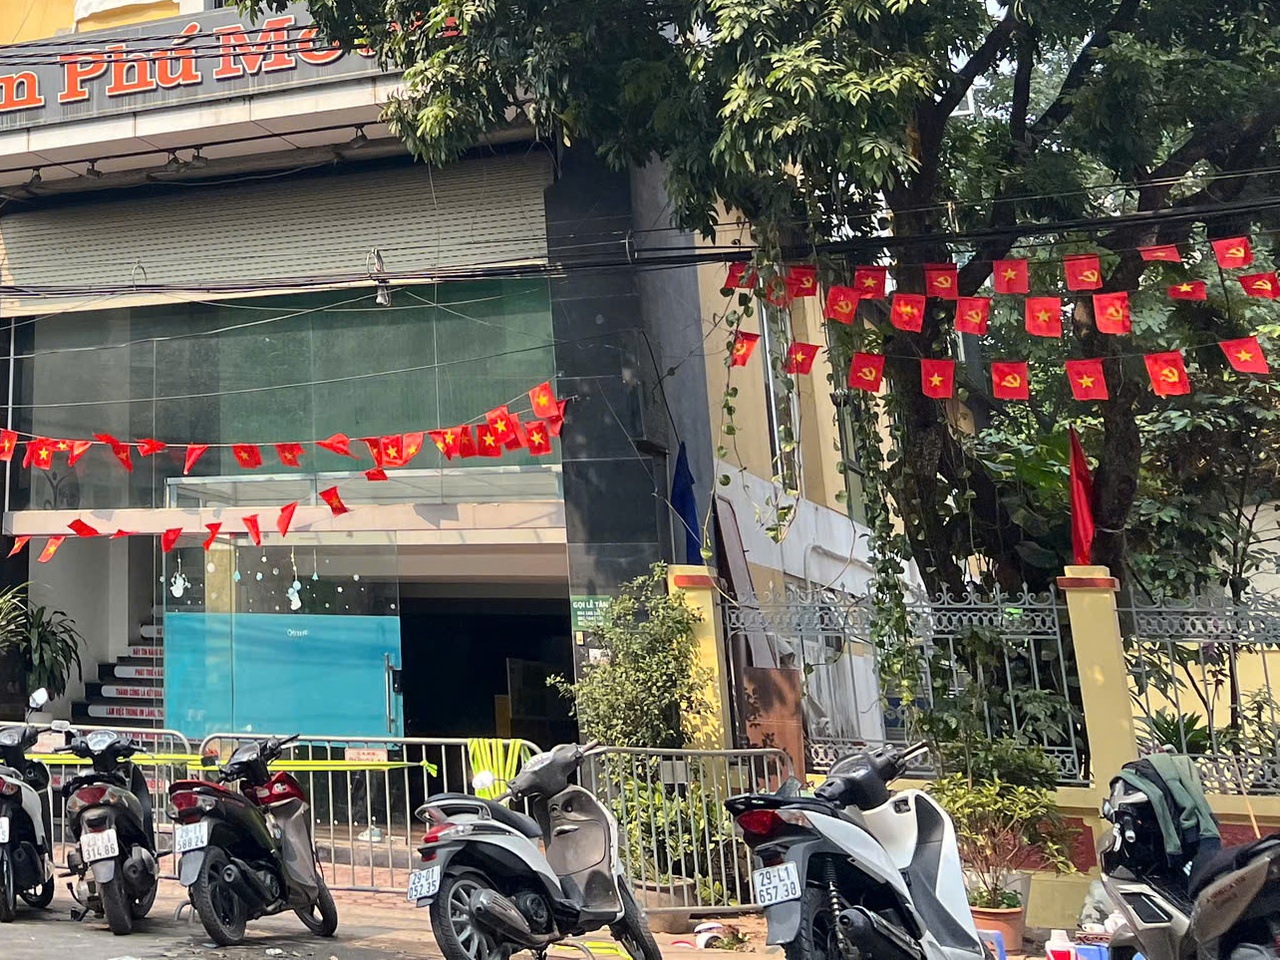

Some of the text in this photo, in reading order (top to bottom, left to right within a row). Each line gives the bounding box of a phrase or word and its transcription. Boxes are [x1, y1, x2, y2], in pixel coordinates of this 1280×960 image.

[58, 22, 201, 103] Phú
[759, 866, 791, 887] 29-L1
[758, 881, 797, 904] 657.38
